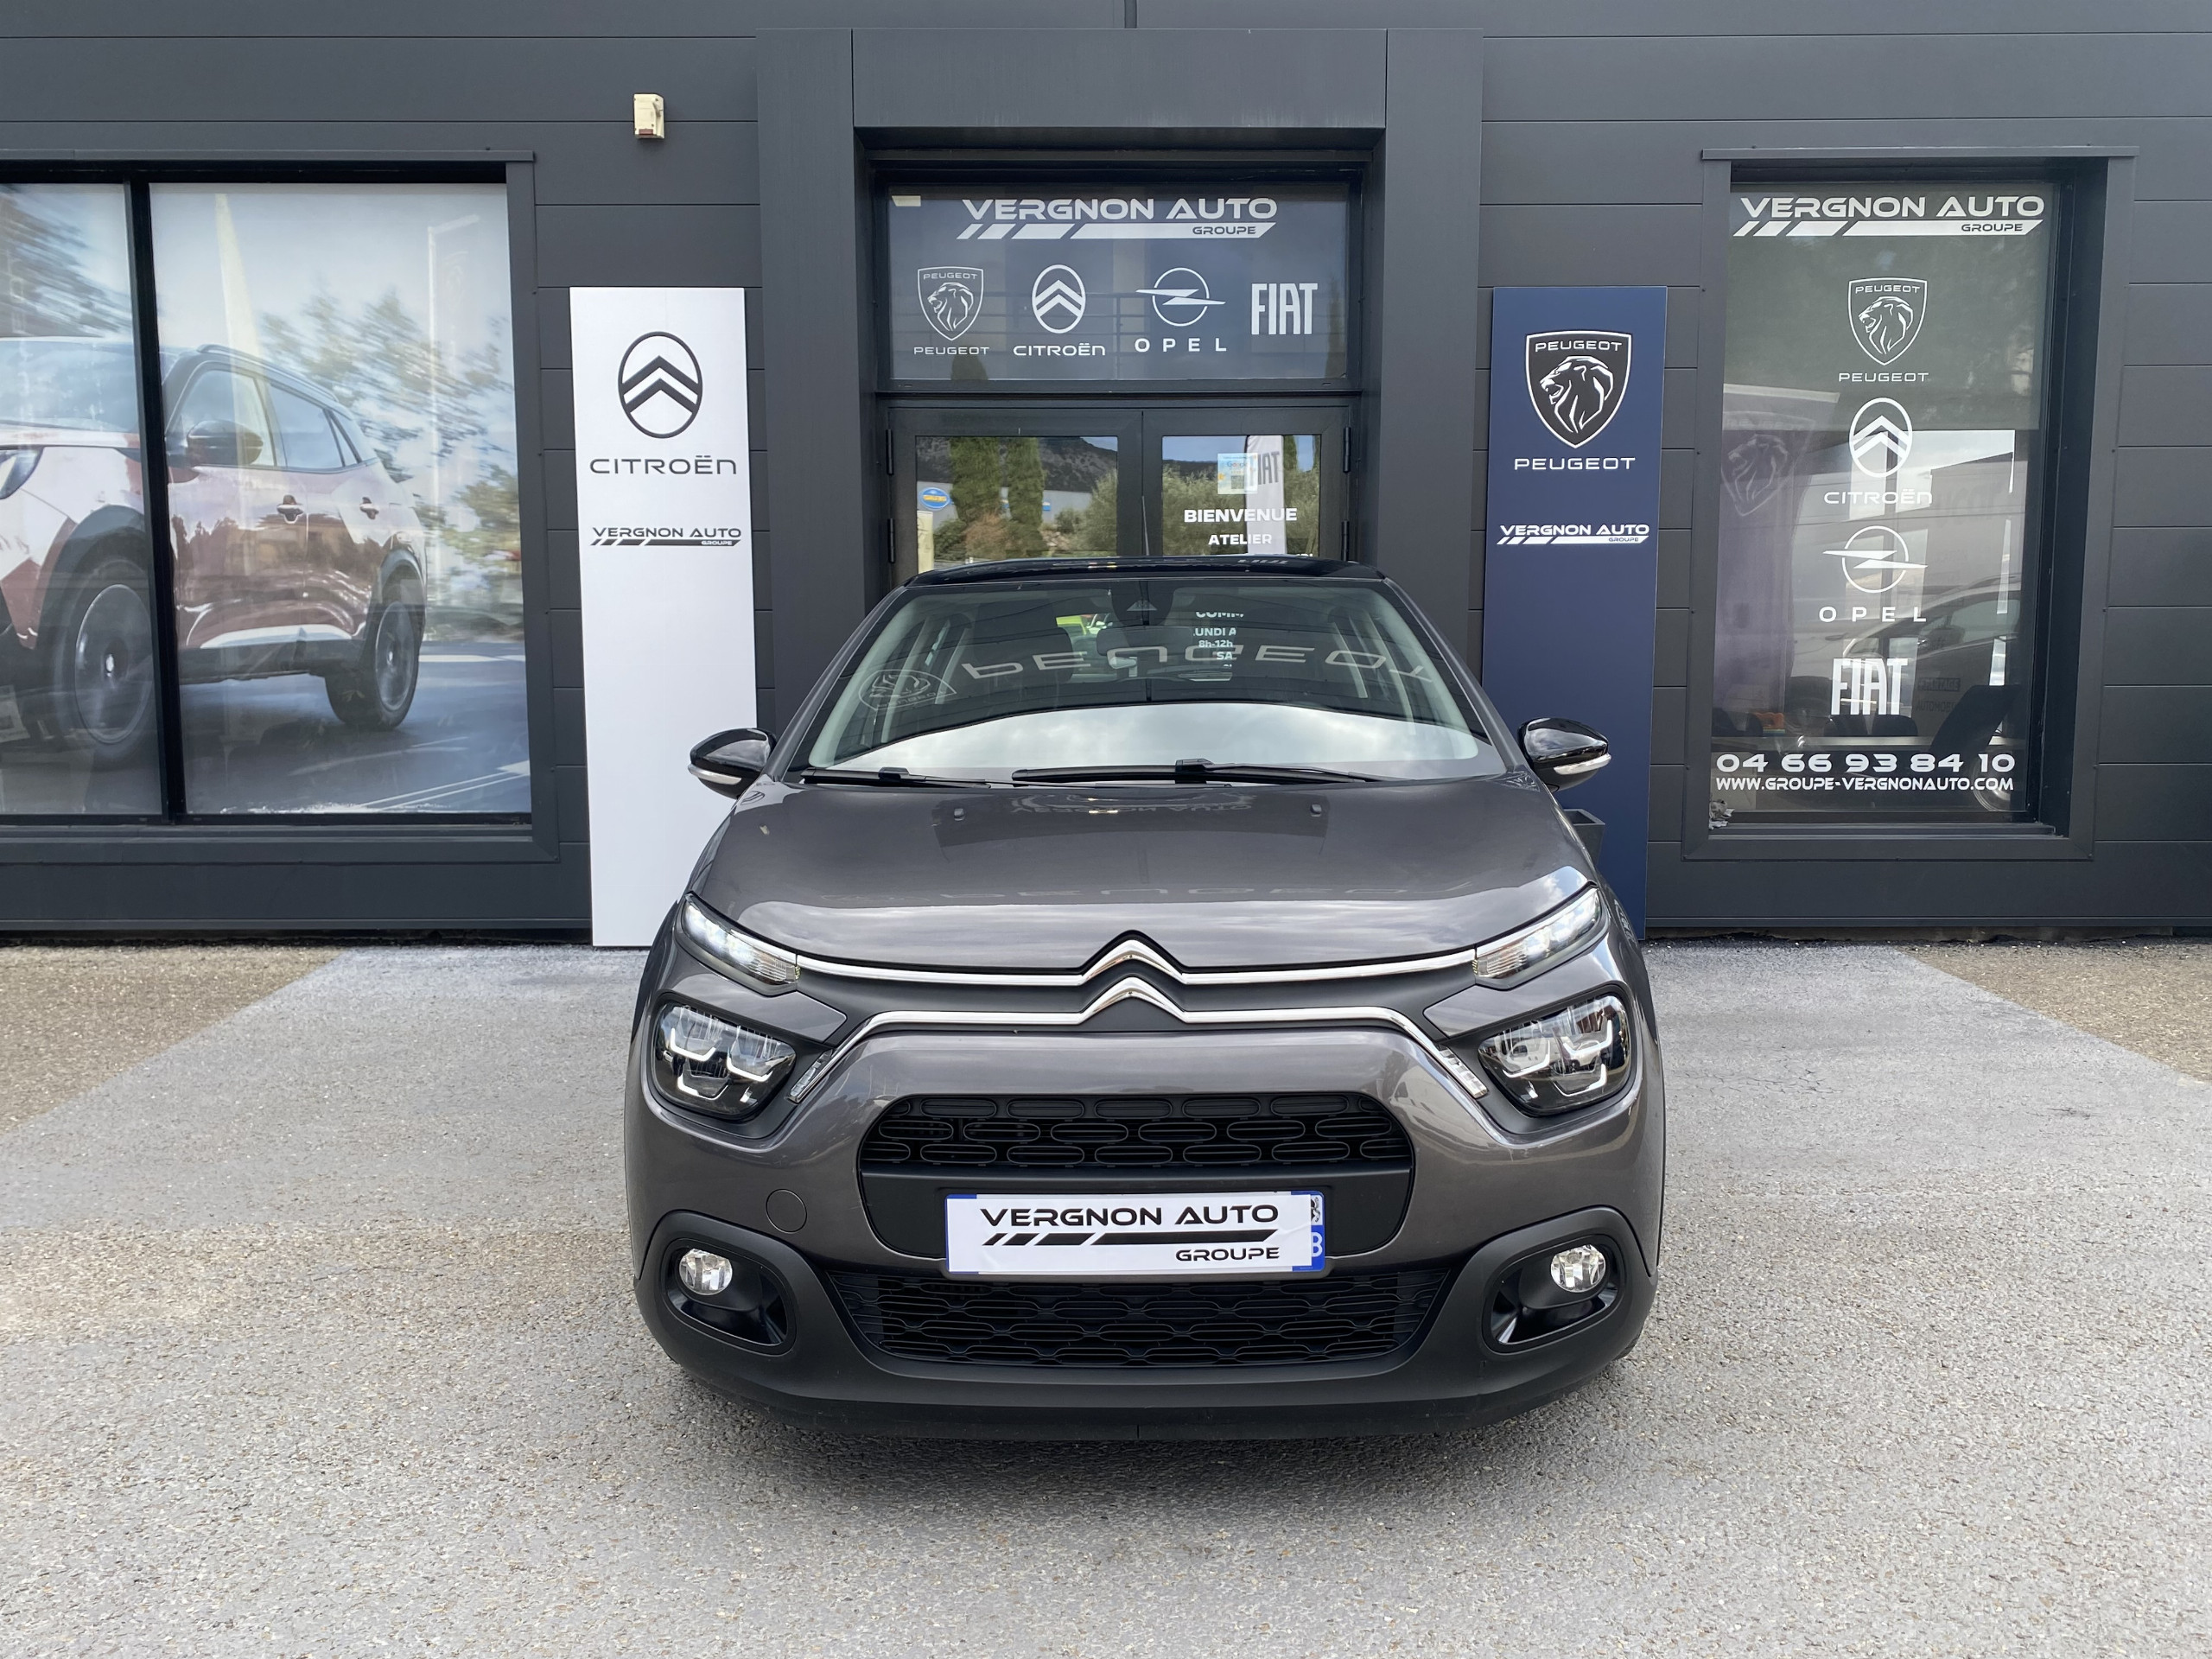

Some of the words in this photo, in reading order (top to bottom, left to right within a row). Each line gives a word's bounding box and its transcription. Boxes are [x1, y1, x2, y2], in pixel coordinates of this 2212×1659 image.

[962, 198, 1154, 220] VERGNON
[1166, 197, 1277, 219] AUTO
[1739, 197, 1926, 218] VERGNON
[1936, 195, 2044, 217] AUTO
[1192, 226, 1257, 236] GROUPE
[1961, 223, 2024, 232] GROUPE
[923, 272, 978, 281] PEUGEOT
[1854, 283, 1921, 295] PEUGEOT
[1251, 283, 1319, 335] FIAT
[913, 346, 990, 355] PEUGEOT
[1134, 337, 1228, 353] OPEL
[1535, 340, 1623, 353] PEUGEOT
[1838, 372, 1929, 383] PEUGEOT
[1514, 457, 1636, 471] PEUGEOT
[1184, 508, 1298, 523] BIENVENUE
[592, 527, 683, 537] VERGNON
[689, 527, 741, 537] AUTO
[1499, 524, 1592, 536] VERGNON
[1595, 523, 1649, 536] AUTO
[1208, 533, 1272, 545] ATELIER
[1819, 605, 1927, 623] OPEL
[1193, 627, 1225, 636] UNDI
[1830, 658, 1909, 715] FIAT
[1716, 753, 1768, 772] 04
[1781, 753, 1832, 772] 66
[1844, 753, 1897, 772] 93
[1910, 753, 1964, 772] 84
[1979, 753, 2015, 772] 10
[1716, 777, 2013, 791] WWW.GROUPE-VERGNONAUTO.COM
[980, 1207, 1162, 1227] VERGNON
[1174, 1203, 1279, 1225] AUTO
[1176, 1247, 1280, 1262] GROUPE
